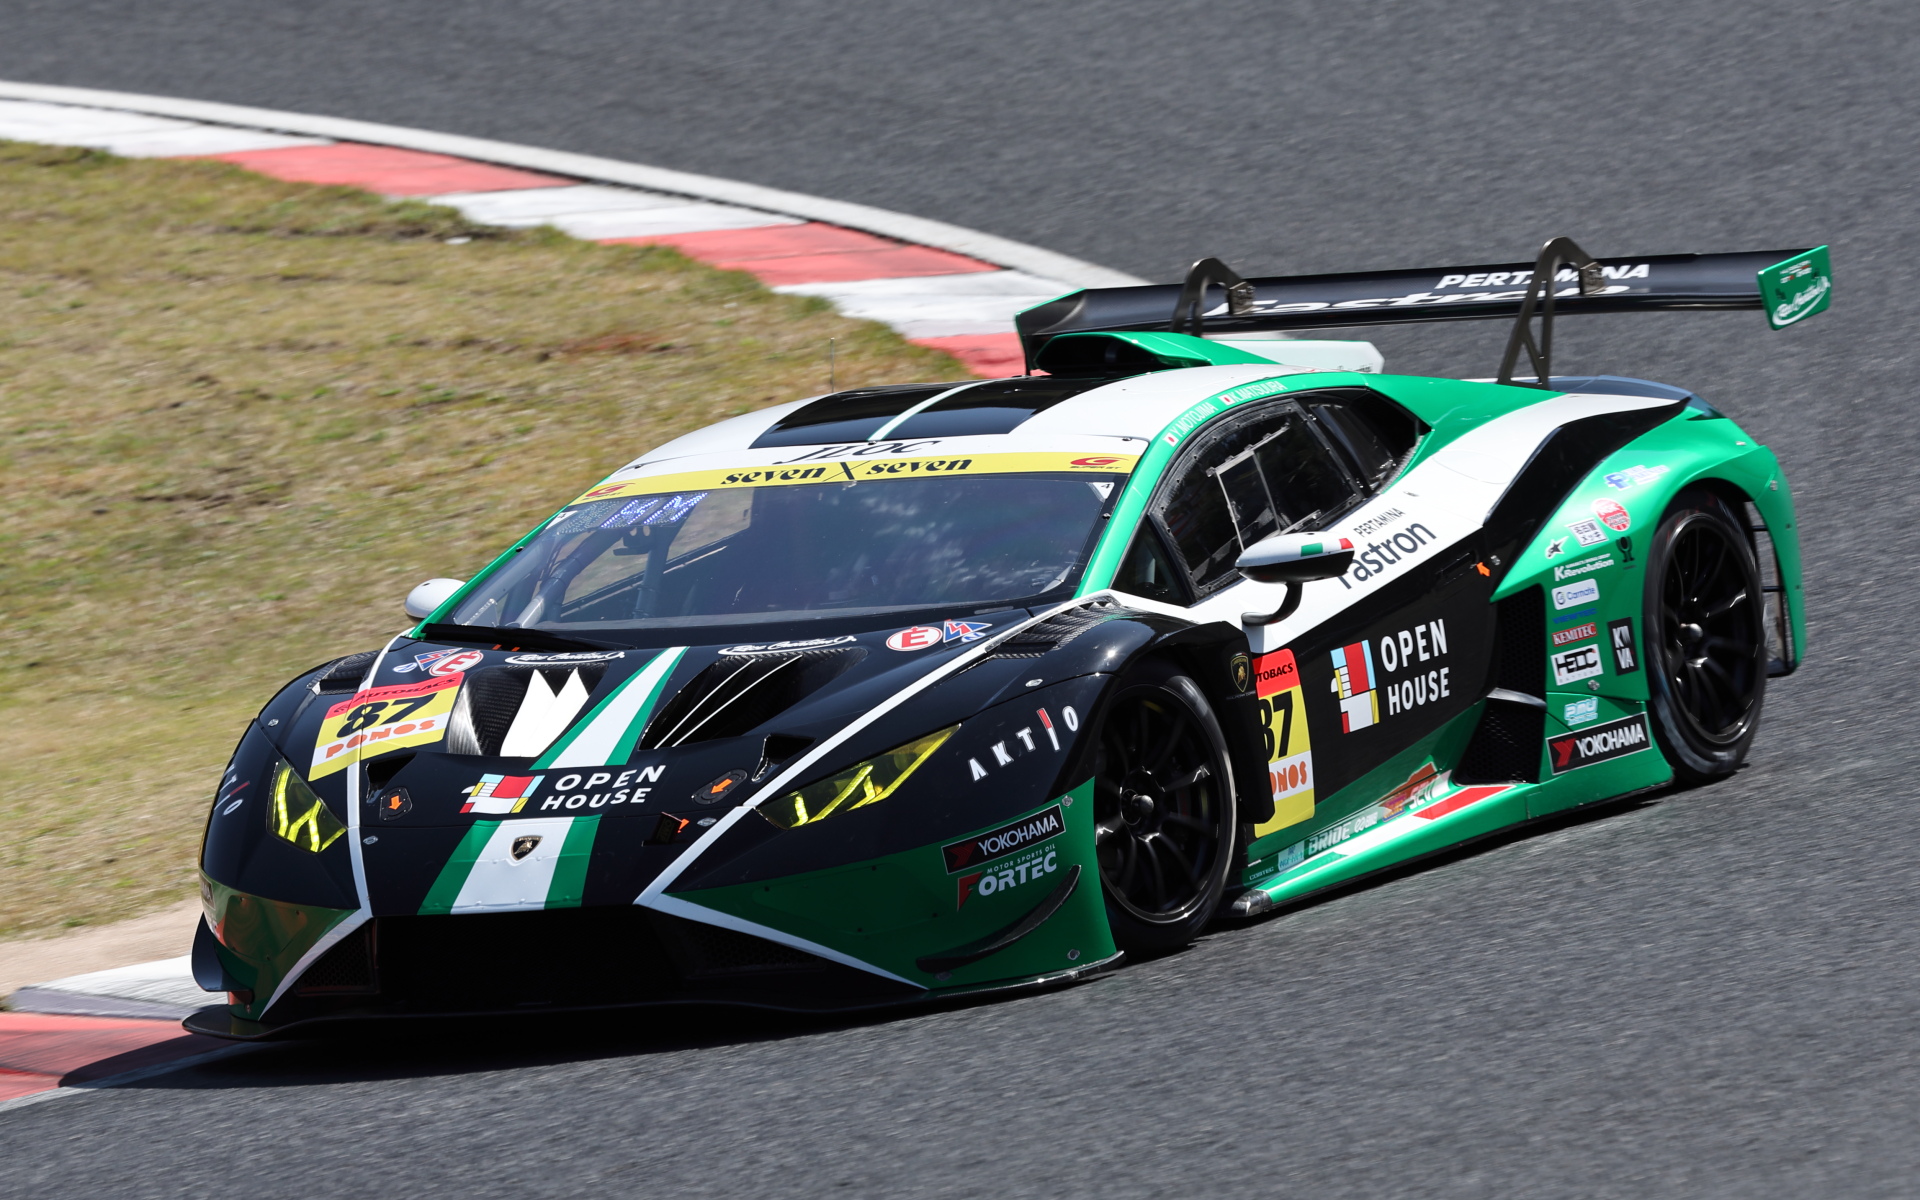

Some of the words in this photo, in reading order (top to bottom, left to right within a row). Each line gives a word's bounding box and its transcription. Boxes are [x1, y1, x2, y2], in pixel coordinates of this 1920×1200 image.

[1434, 263, 1650, 290] PERTMNA
[720, 467, 827, 485] seven
[865, 458, 973, 476] seven
[1353, 507, 1405, 538] PERTAMINA
[1338, 523, 1437, 590] astron
[1381, 618, 1448, 673] OPEN
[1553, 624, 1597, 645] KEMITEC
[1255, 662, 1294, 683] TOBACS
[1387, 666, 1450, 716] HOUSE
[336, 692, 438, 738] 87
[325, 719, 436, 759] PONOS
[1575, 722, 1647, 759] YOKOHAMA
[554, 765, 667, 791] OPEN
[540, 787, 652, 811] HOUSE
[977, 814, 1059, 856] YOKOHAMA
[1308, 822, 1351, 857] BRIDE
[986, 860, 1014, 874] MOTOR
[1017, 849, 1043, 863] SPORTS
[1045, 843, 1056, 853] OIL
[957, 851, 1058, 913] FORTEC
